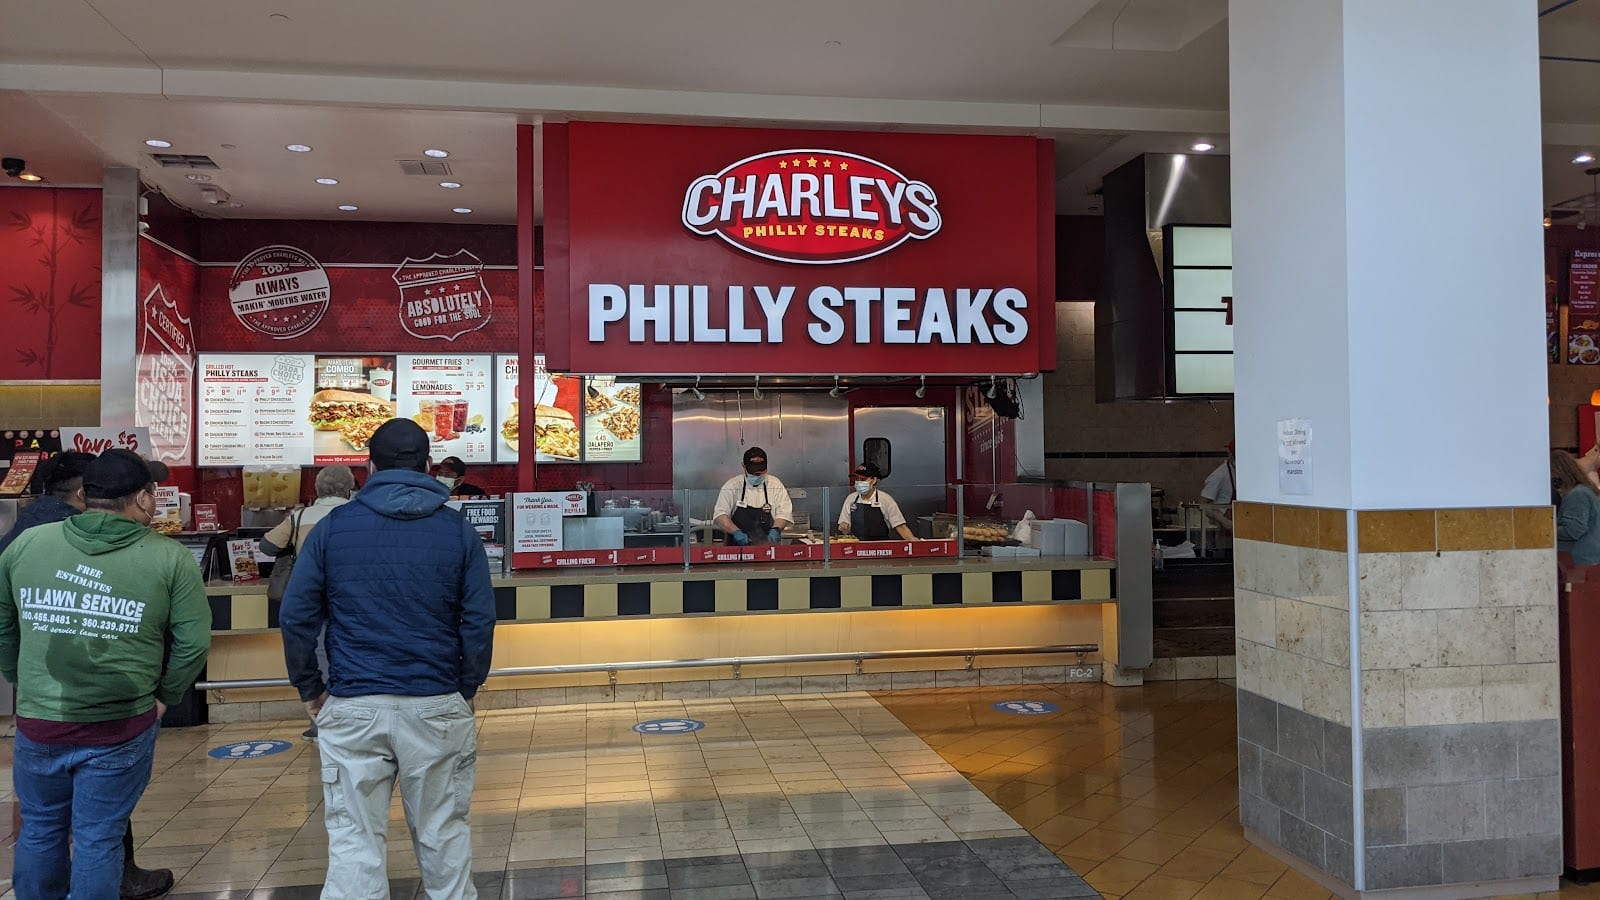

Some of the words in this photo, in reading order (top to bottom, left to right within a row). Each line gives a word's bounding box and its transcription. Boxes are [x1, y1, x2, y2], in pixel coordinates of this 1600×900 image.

[686, 173, 939, 231] CHARLEYS
[743, 224, 808, 238] PHILLY
[815, 225, 885, 241] STEAKS
[413, 270, 438, 280] APPROVED
[255, 277, 300, 296] ALWAYS
[267, 295, 299, 308] MOUTHS
[300, 291, 327, 302] WATER
[407, 290, 482, 318] ABSOLUTELY
[414, 317, 432, 328] GOOD
[450, 311, 462, 322] THE
[463, 308, 482, 320] SOUL
[588, 284, 796, 343] PHILLY
[807, 286, 1028, 345] STEAKS
[158, 311, 185, 349] CERTIFIED
[151, 357, 182, 408] USDA
[272, 369, 301, 380] CHOICE
[141, 377, 188, 439] CHOICE
[73, 433, 114, 453] Save
[118, 430, 138, 452] $5
[608, 550, 617, 563] #1
[766, 546, 775, 559] #1
[904, 543, 912, 555] #1
[76, 564, 104, 578] FREE
[56, 570, 112, 594] ESTIMATES
[36, 588, 77, 608] LAWN
[80, 592, 146, 618] SERVICE
[32, 622, 48, 632] Full
[50, 626, 76, 636] service
[82, 618, 139, 634] 360.239.8731
[1070, 668, 1093, 678] FC-2
